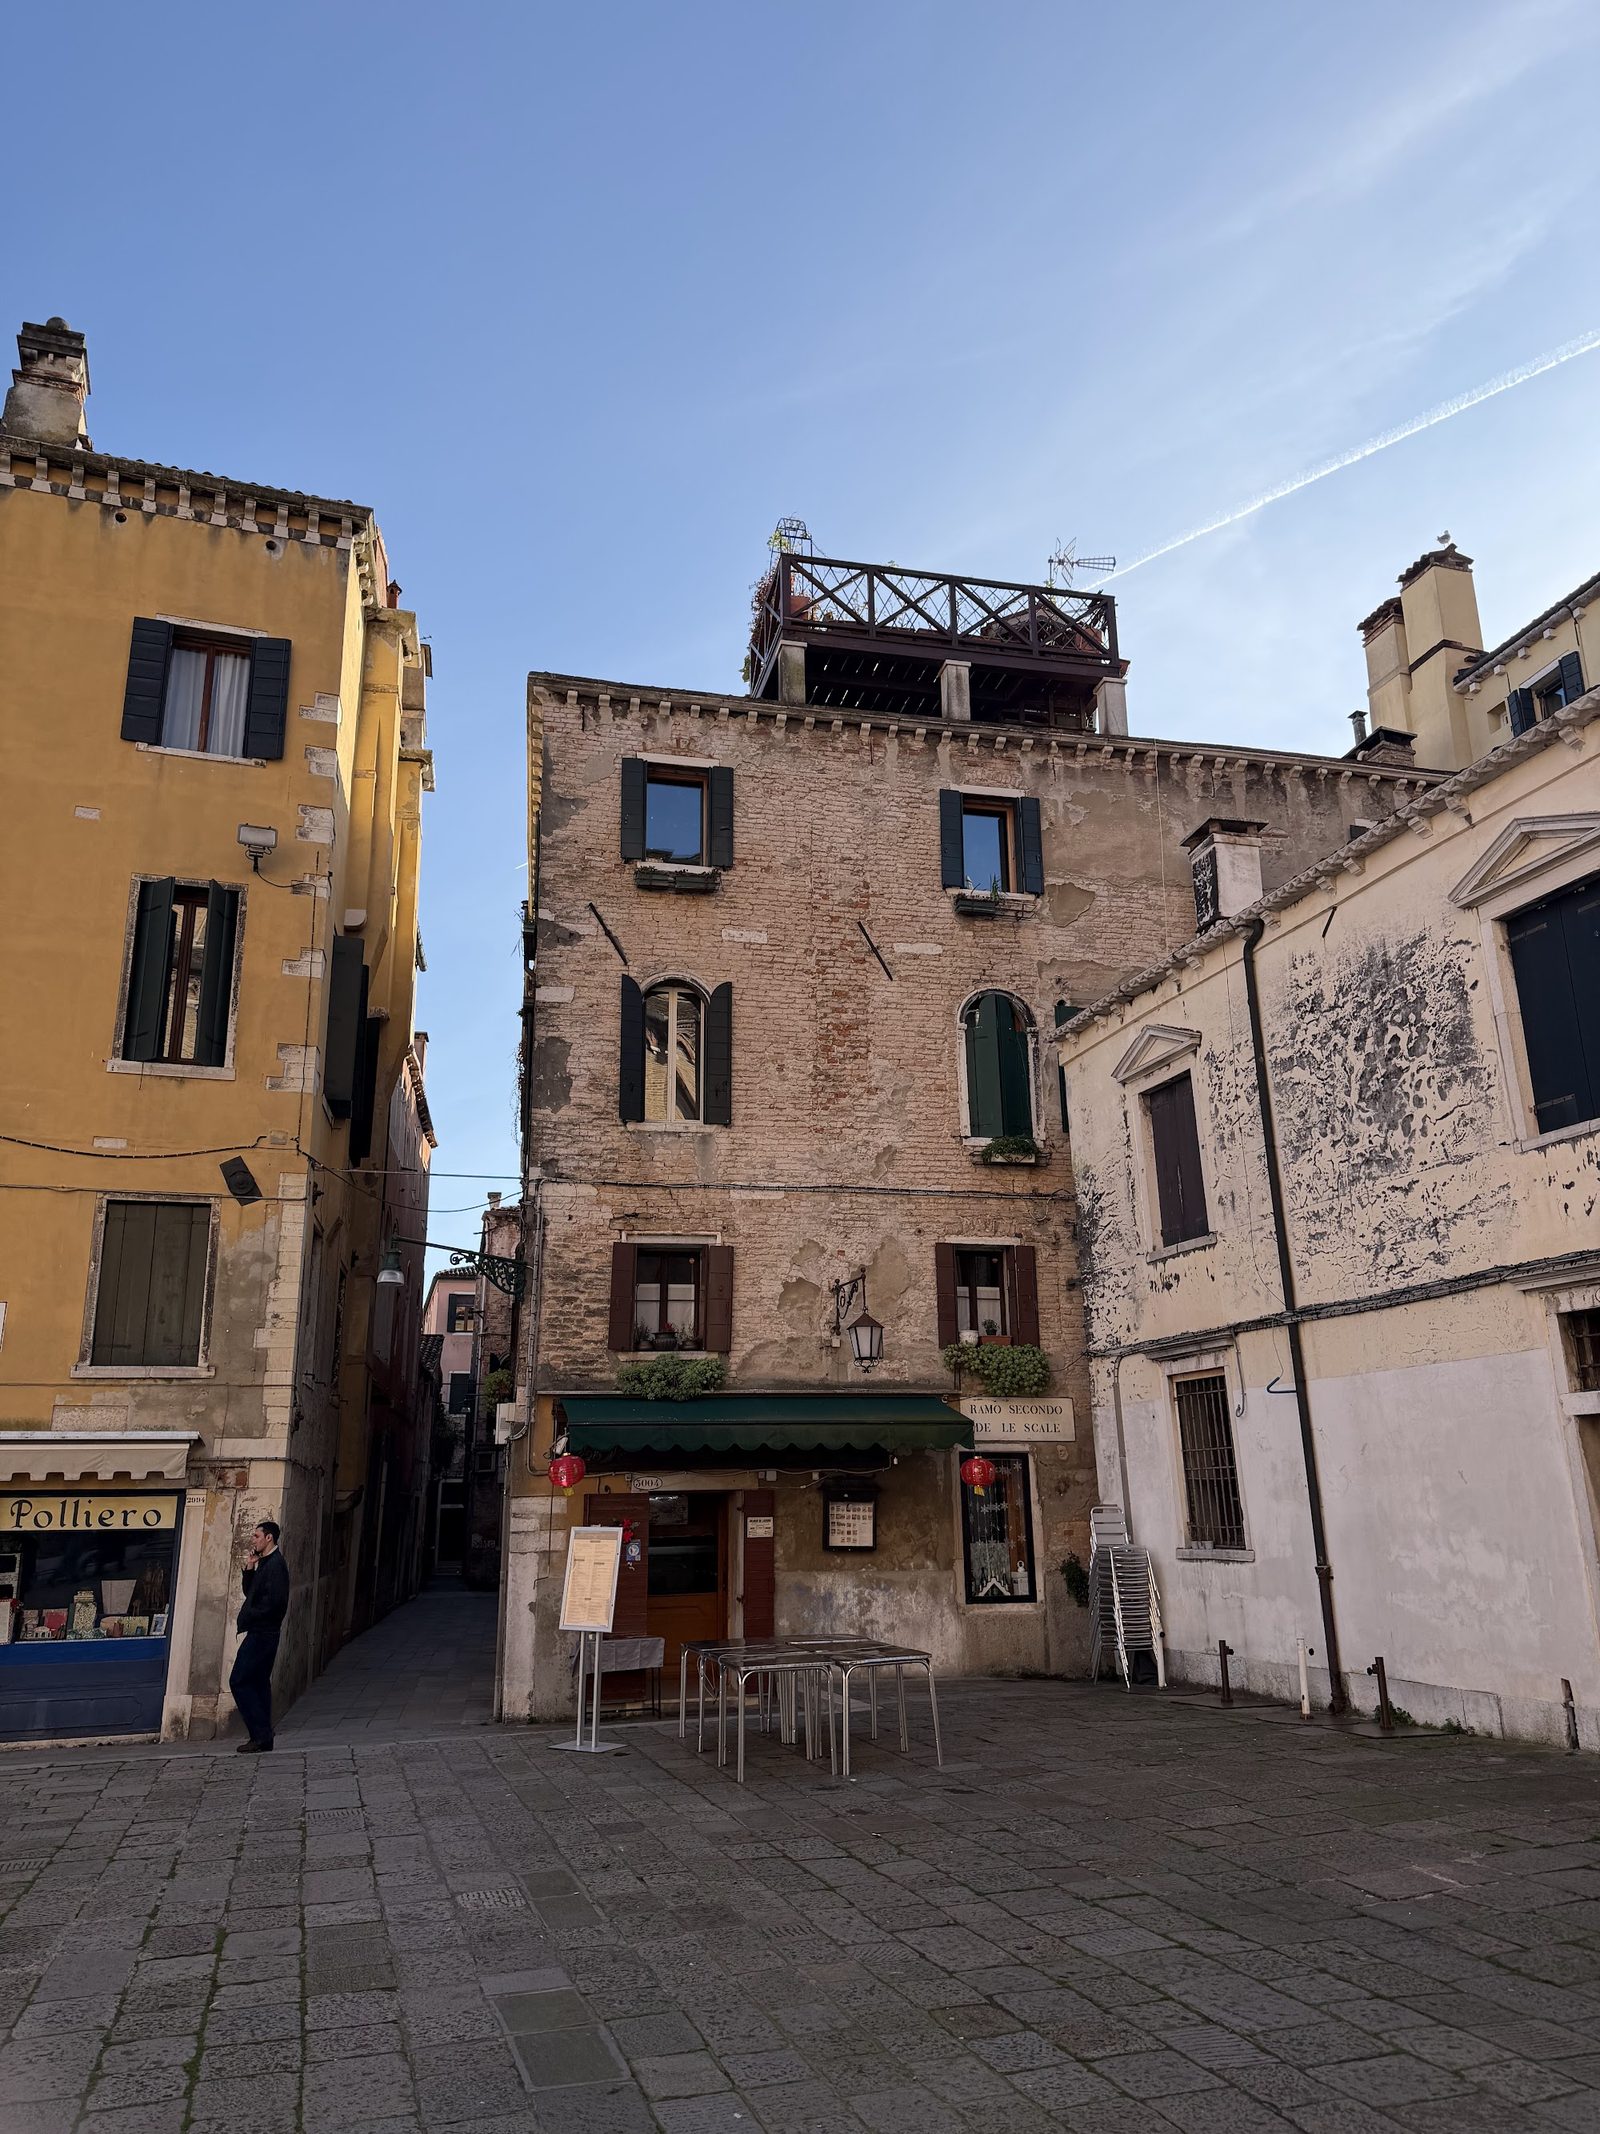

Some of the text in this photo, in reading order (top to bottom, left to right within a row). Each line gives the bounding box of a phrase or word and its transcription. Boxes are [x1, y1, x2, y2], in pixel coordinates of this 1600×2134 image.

[970, 1404, 1063, 1415] RAMO SECONDO
[975, 1422, 1061, 1433] DE LE SCALE
[10, 1499, 162, 1529] Polliero
